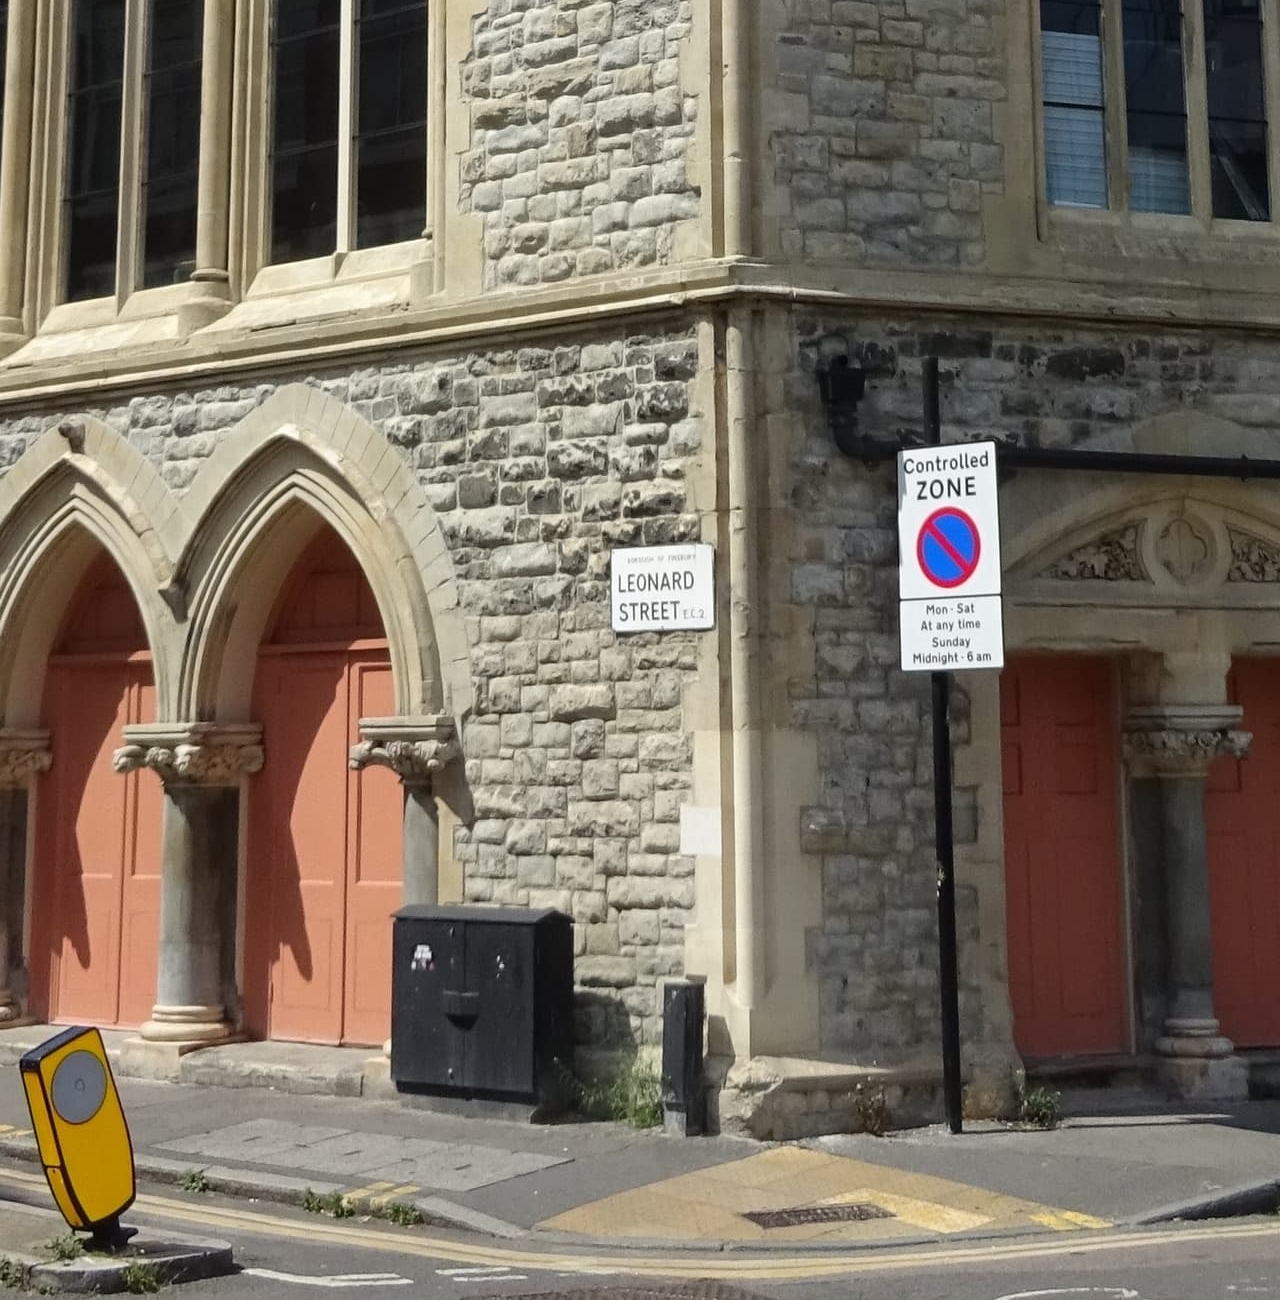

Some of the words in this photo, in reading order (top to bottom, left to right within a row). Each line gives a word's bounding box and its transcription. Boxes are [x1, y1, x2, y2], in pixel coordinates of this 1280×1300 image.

[904, 450, 989, 474] Controlled
[917, 476, 977, 501] ZONE
[618, 571, 695, 593] LEONARD
[619, 600, 681, 622] STREET
[926, 605, 948, 615] Mon
[957, 603, 975, 614] Sat
[921, 620, 932, 631] At
[936, 622, 954, 632] any
[958, 618, 981, 629] time
[932, 636, 971, 648] Sunday
[913, 652, 958, 665] Midnight
[967, 651, 973, 662] 6
[976, 654, 992, 662] am
